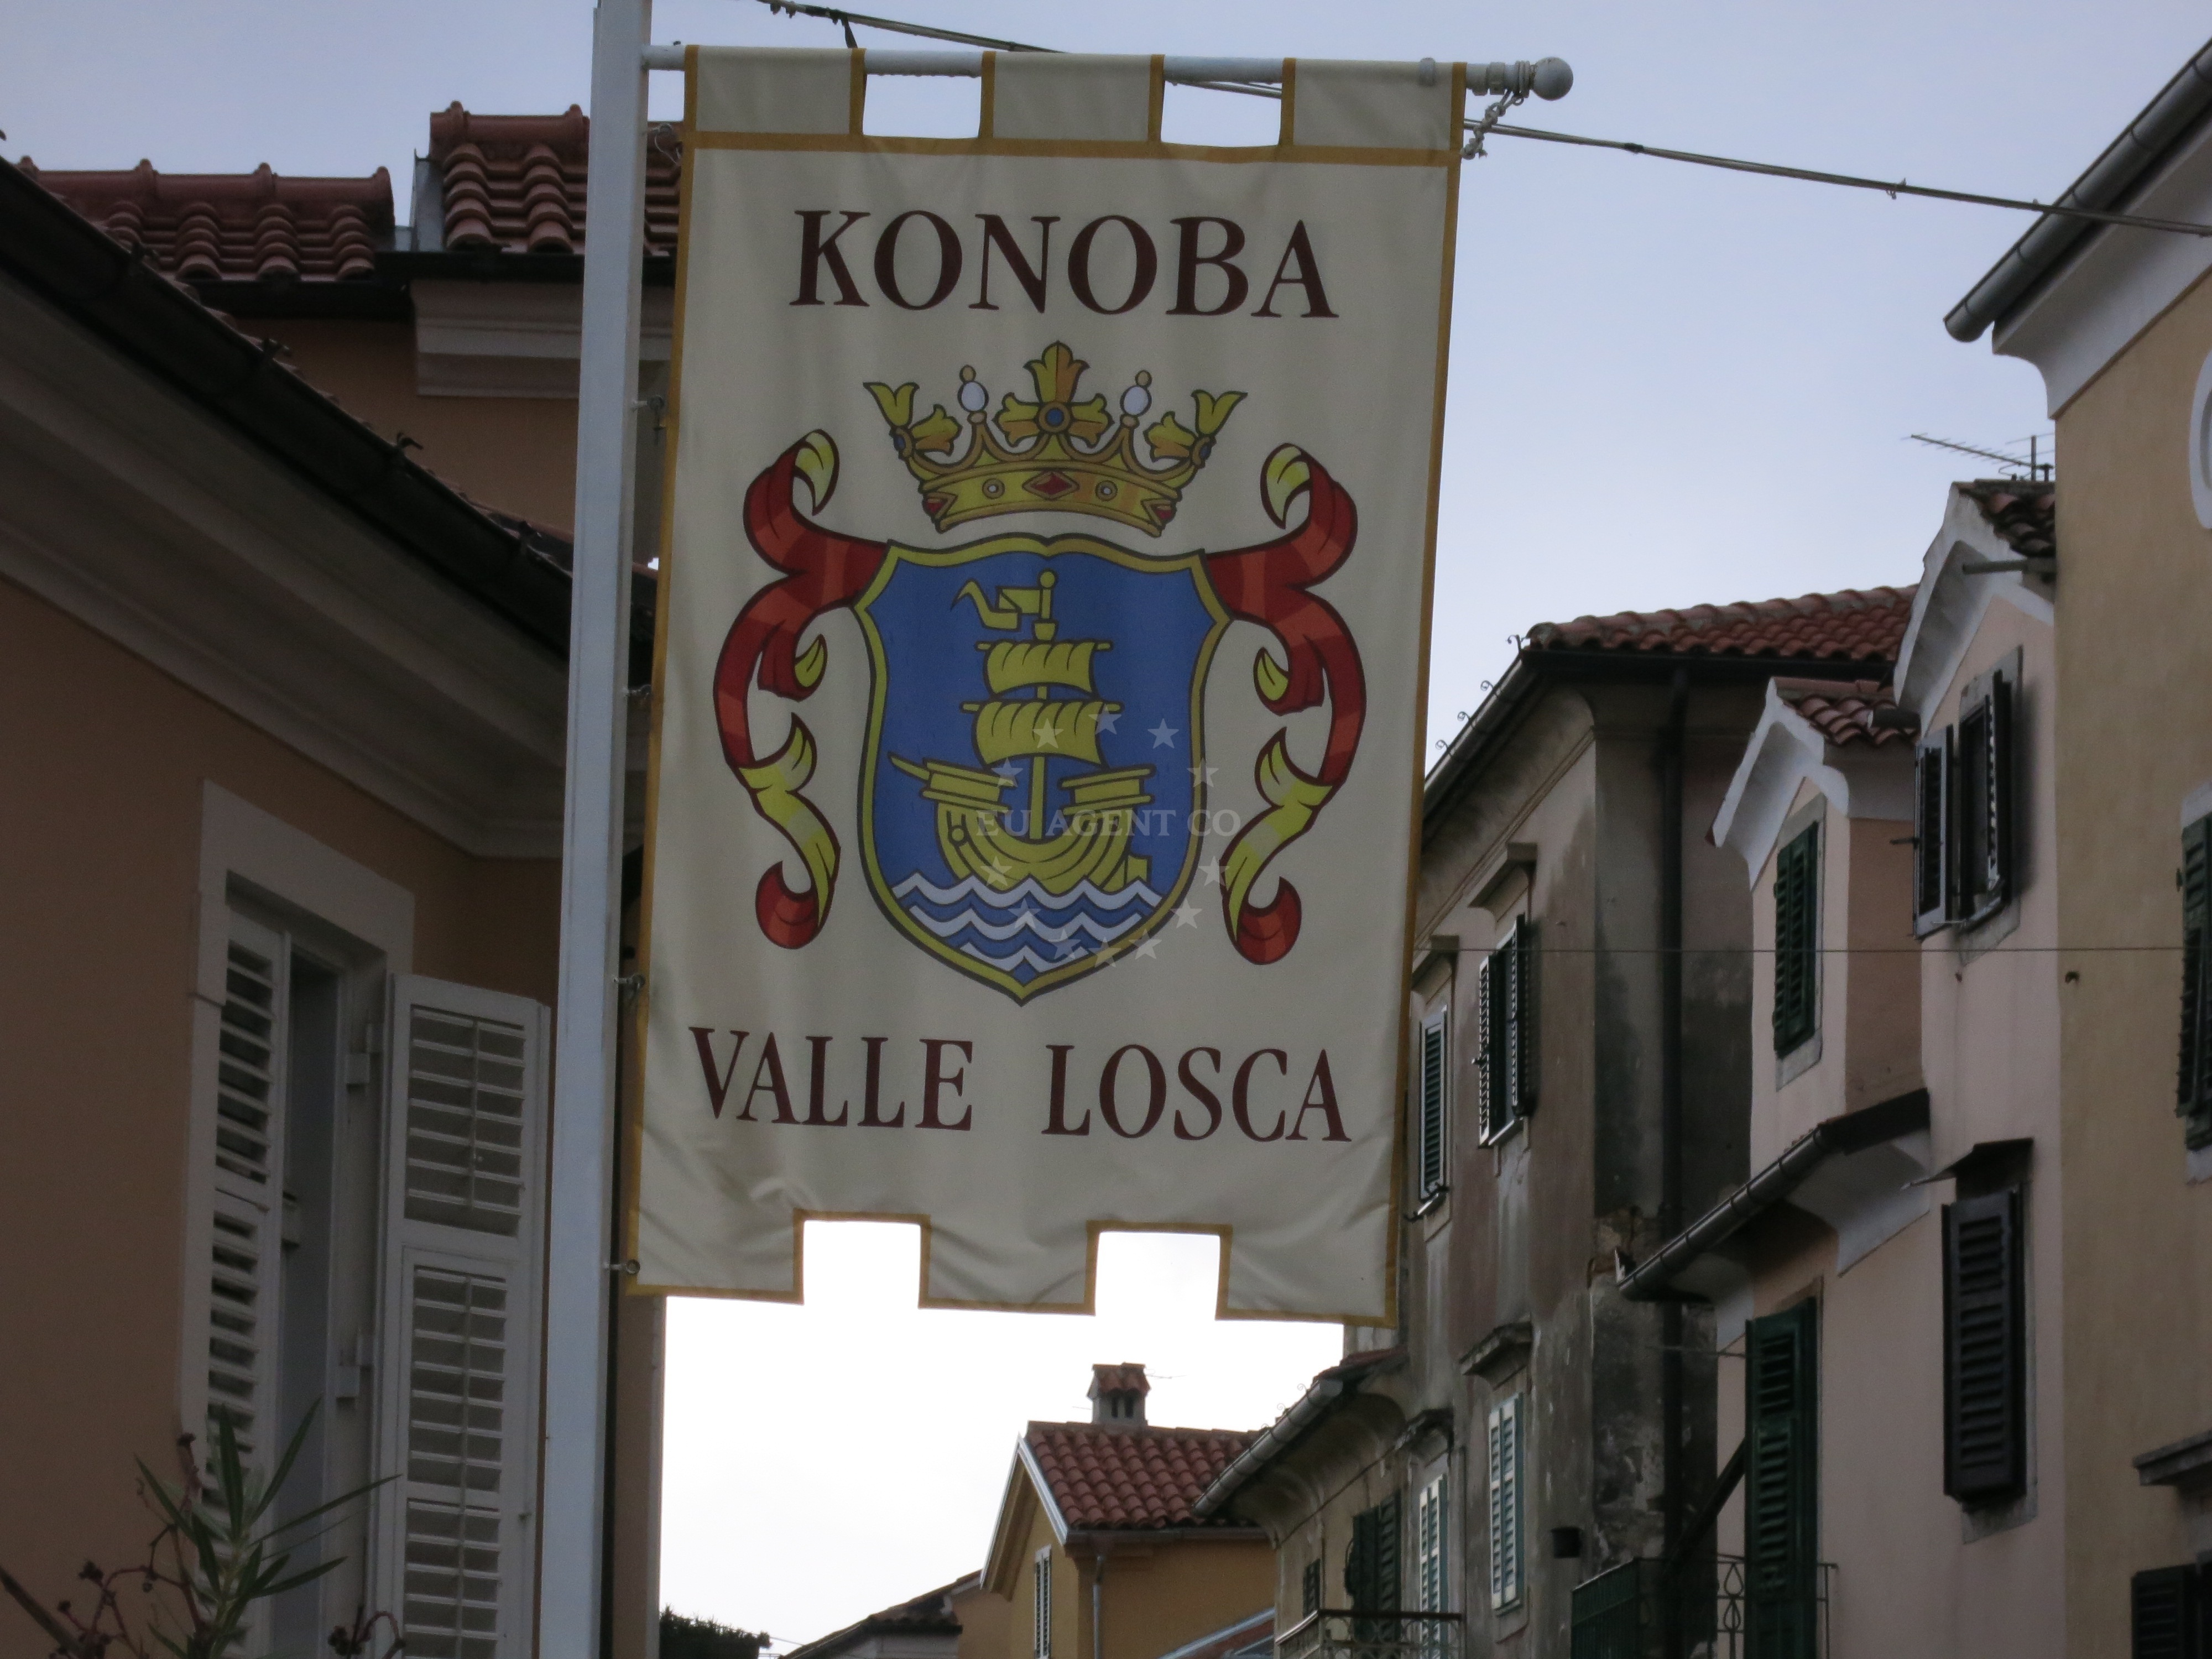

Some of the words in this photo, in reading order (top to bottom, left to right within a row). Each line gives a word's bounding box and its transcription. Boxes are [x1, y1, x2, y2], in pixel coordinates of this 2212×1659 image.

[789, 208, 1339, 319] KONOBA
[688, 1026, 973, 1131] VALLE
[1041, 1044, 1353, 1142] LOSCA
